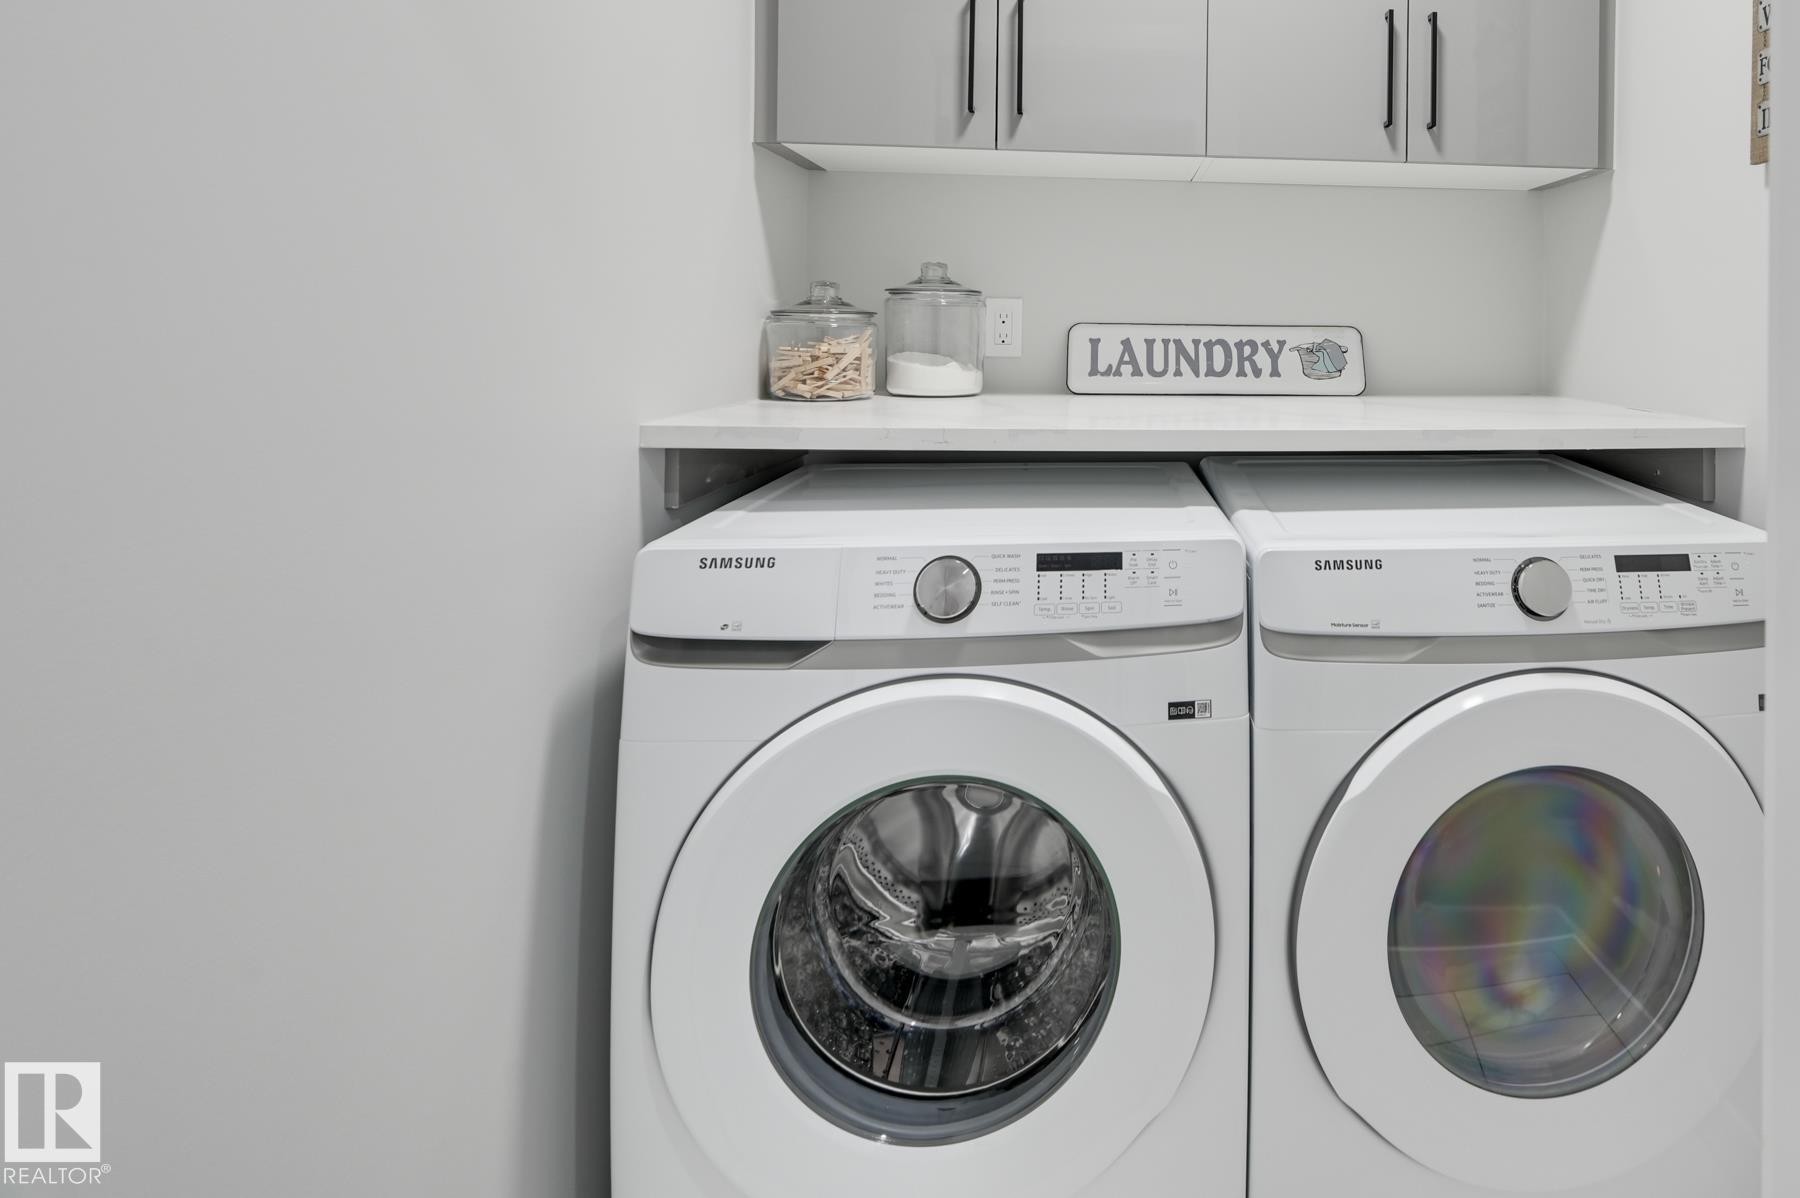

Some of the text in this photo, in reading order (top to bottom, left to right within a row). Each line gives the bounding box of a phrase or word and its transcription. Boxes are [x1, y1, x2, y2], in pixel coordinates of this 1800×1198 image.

[1087, 336, 1287, 379] LAUNDRY
[698, 557, 777, 570] SAMSUNG
[1314, 559, 1383, 571] SAMSUNG
